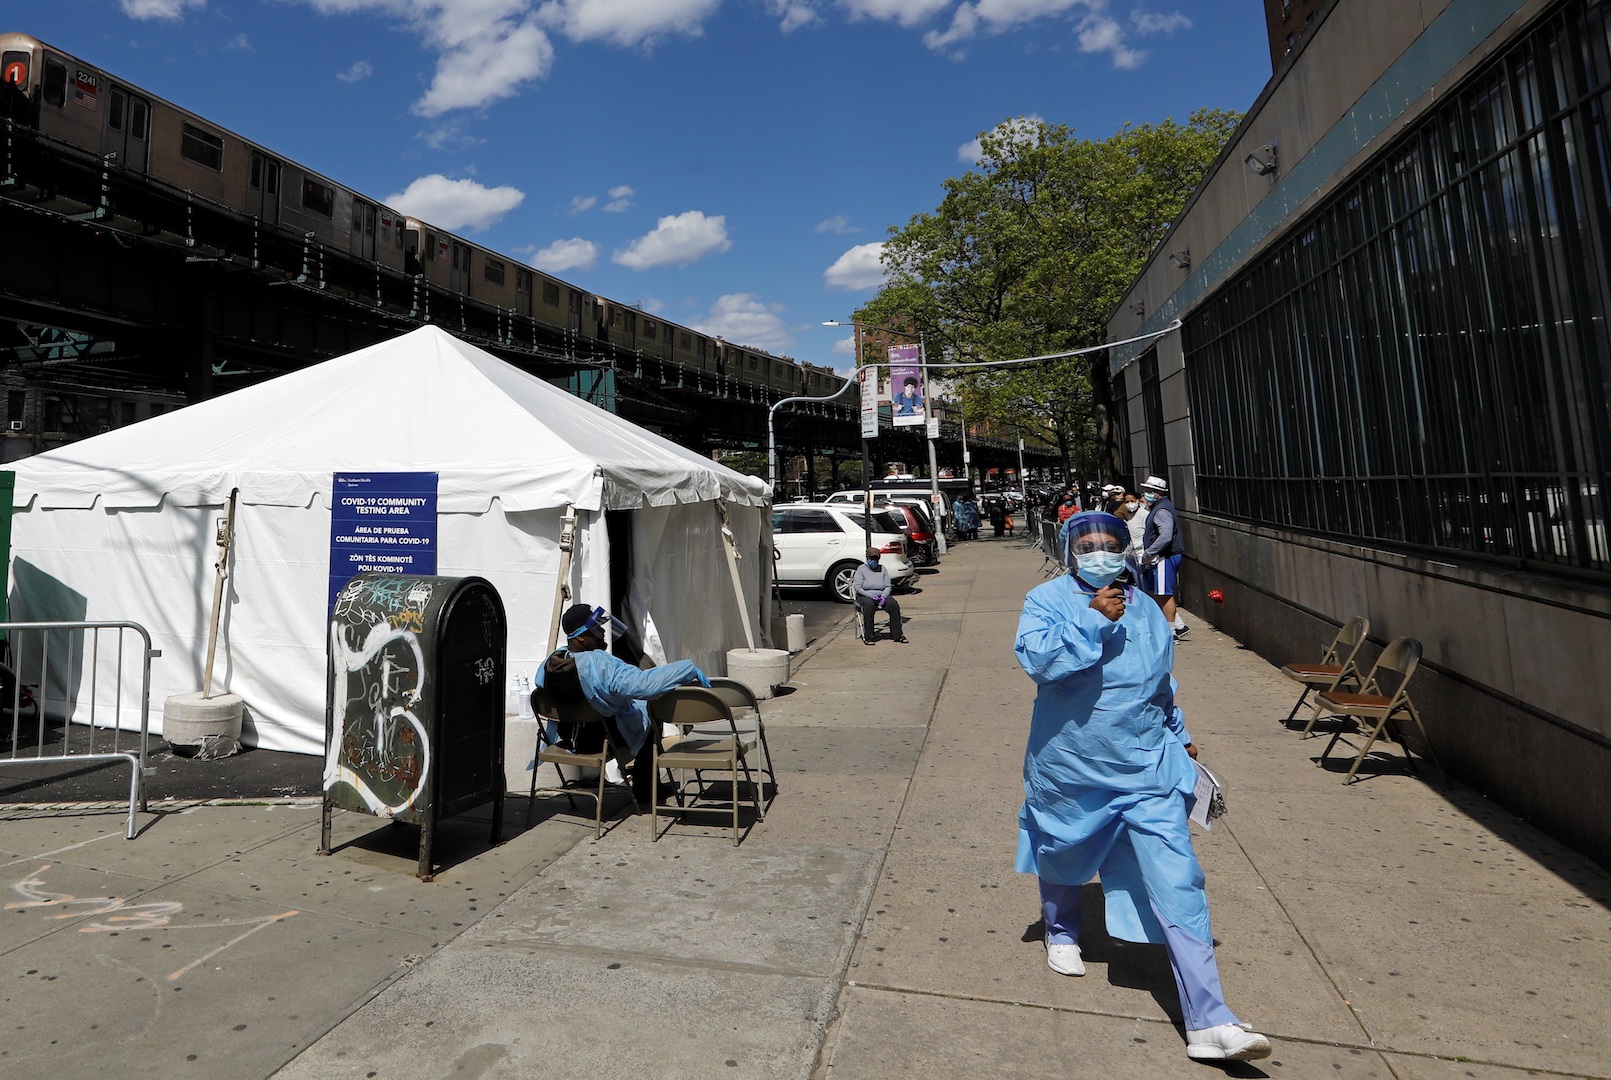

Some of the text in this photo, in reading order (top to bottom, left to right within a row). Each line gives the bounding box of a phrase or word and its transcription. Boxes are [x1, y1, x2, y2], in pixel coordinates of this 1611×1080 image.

[11, 66, 19, 81] 1
[78, 72, 96, 87] 2241
[377, 498, 426, 506] COMMUNITY
[355, 525, 372, 533] ÁREA
[336, 536, 379, 544] COMUNITARIA
[373, 565, 403, 573] KOVID-19
